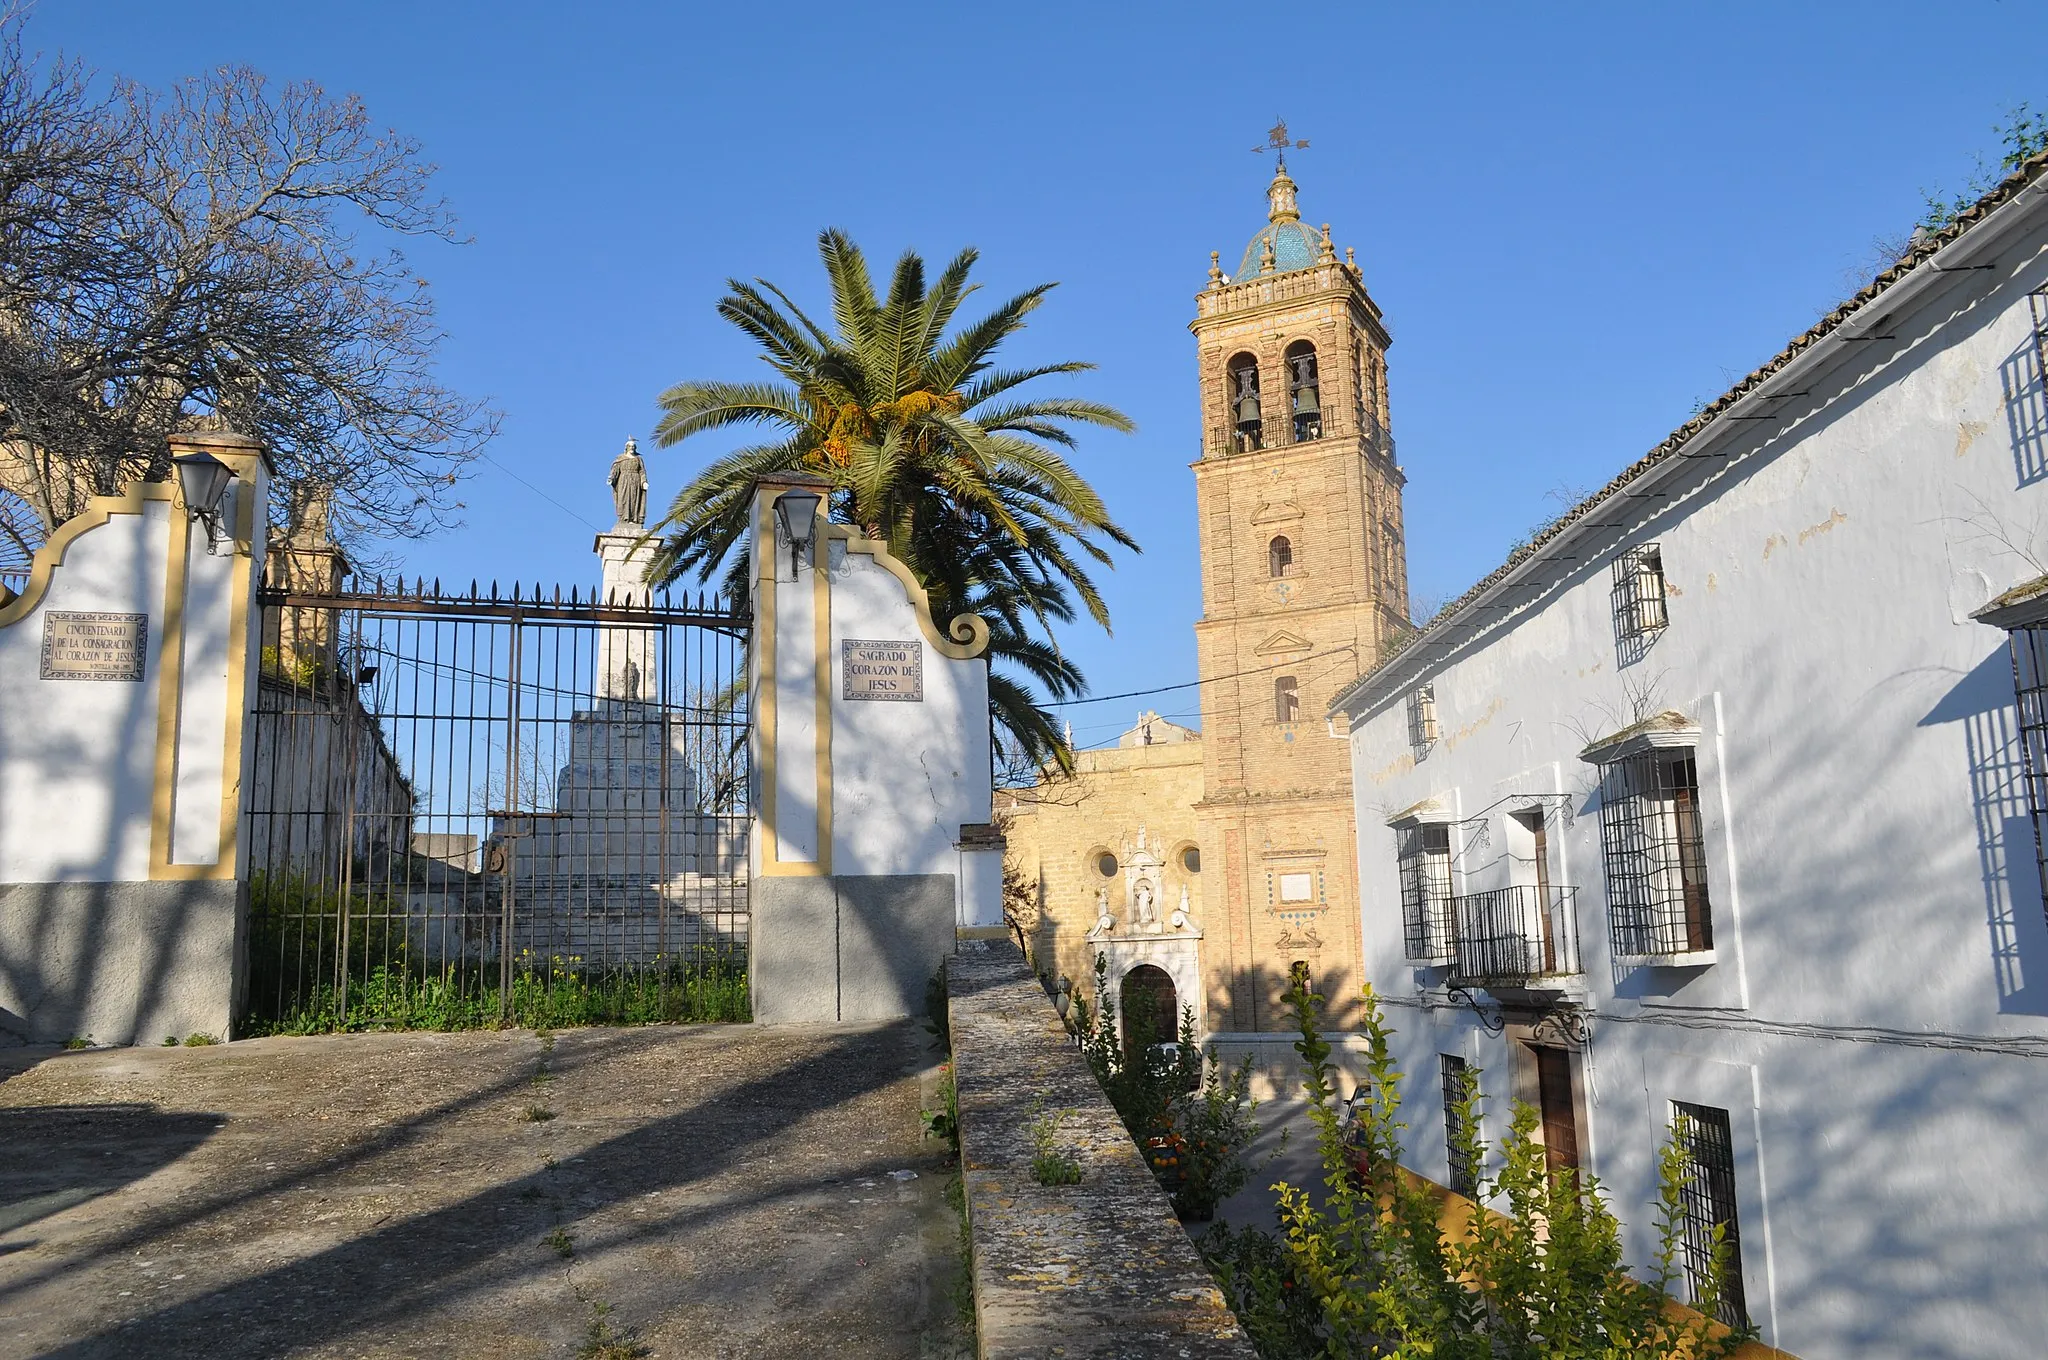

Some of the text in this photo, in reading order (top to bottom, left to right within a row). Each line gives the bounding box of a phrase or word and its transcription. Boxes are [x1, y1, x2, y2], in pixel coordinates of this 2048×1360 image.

[66, 625, 127, 636] CINCUENTENARIO
[57, 638, 66, 647] DE
[69, 638, 79, 648] LA
[53, 650, 63, 660] AL
[104, 652, 112, 661] DE
[116, 652, 136, 662] JESUS
[858, 650, 906, 661] SAGRADO
[902, 666, 914, 676] DE
[869, 679, 897, 691] JESUS
